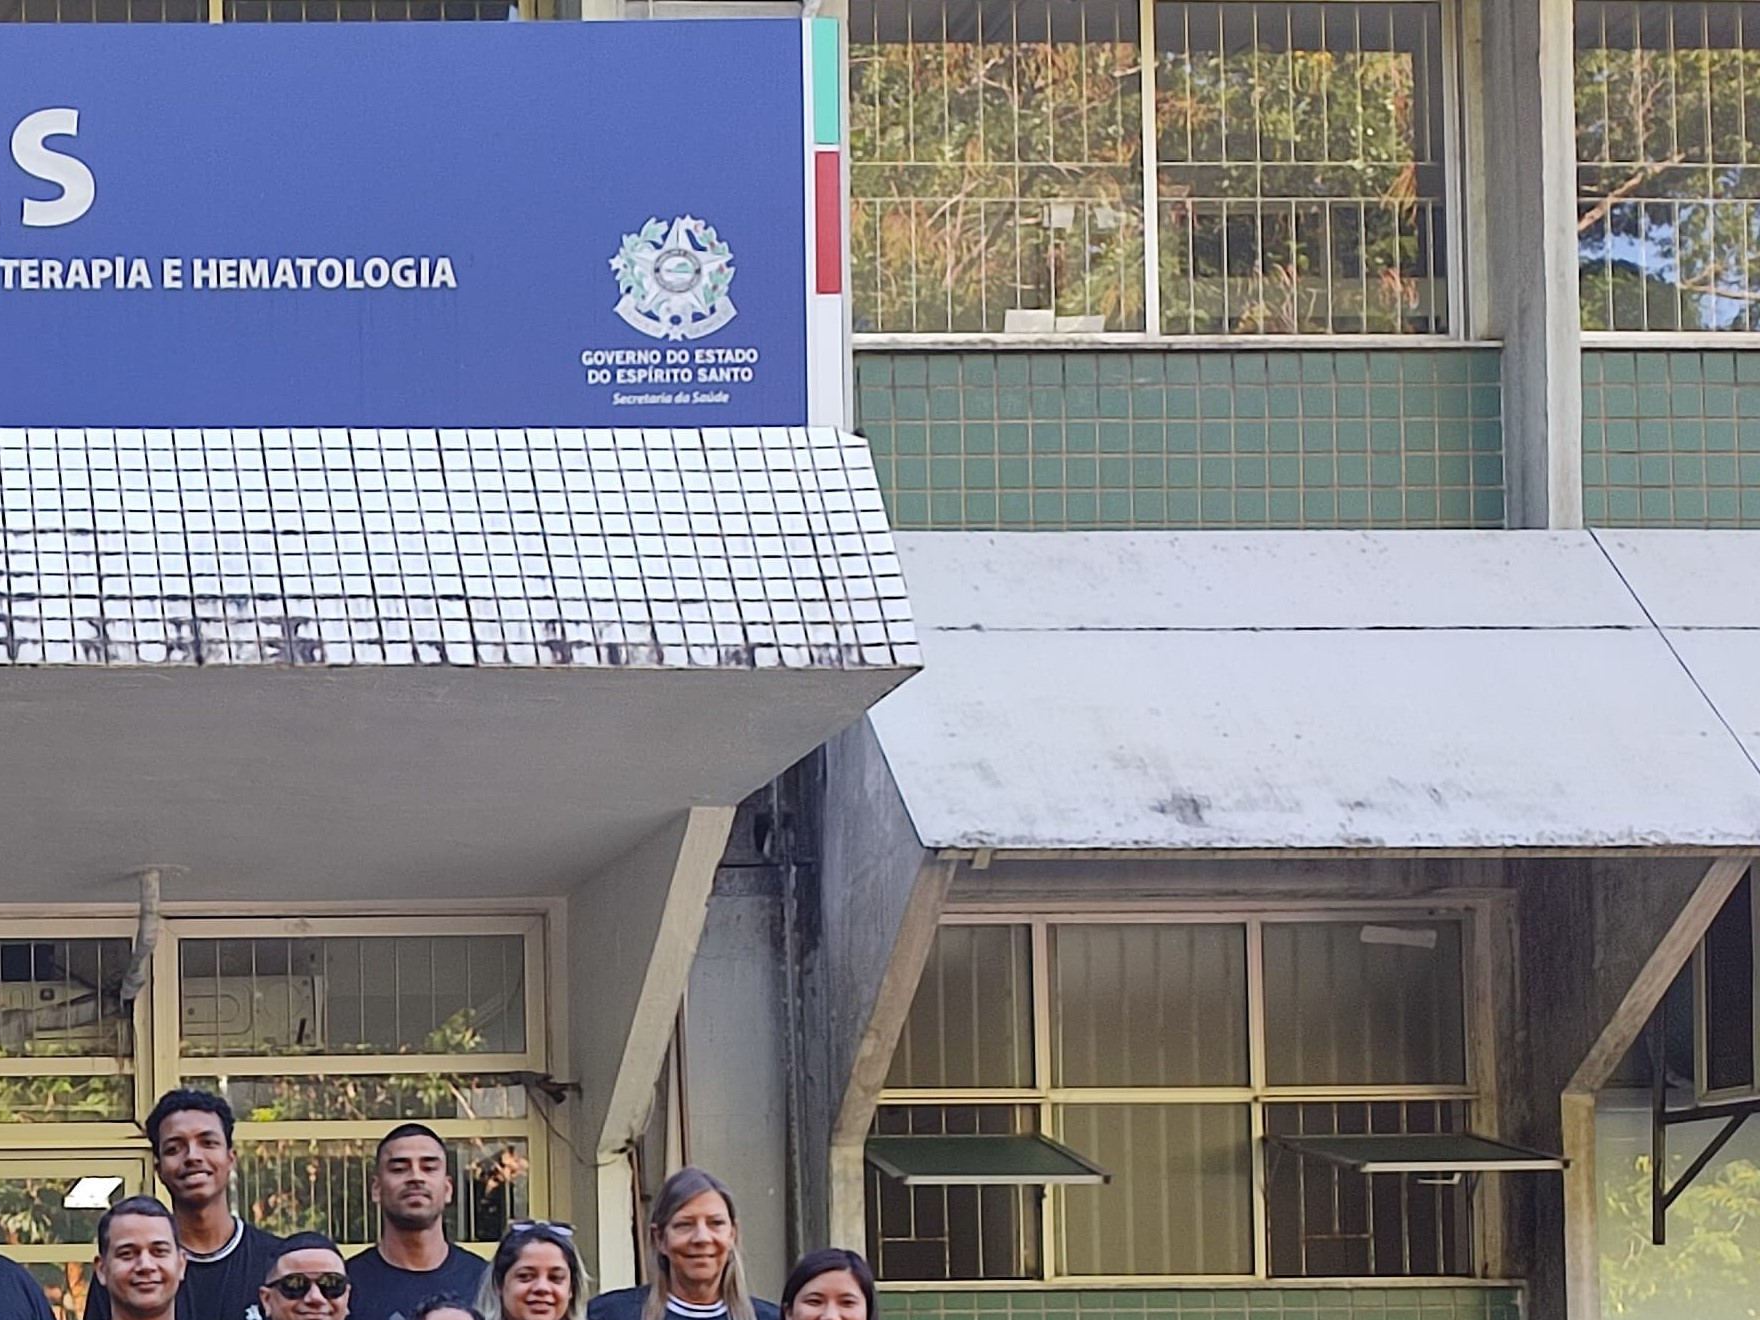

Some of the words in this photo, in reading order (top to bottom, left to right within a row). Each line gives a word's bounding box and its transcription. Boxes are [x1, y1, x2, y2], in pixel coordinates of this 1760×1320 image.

[163, 258, 183, 289] E
[192, 257, 457, 289] HEMATOLOGIA
[581, 349, 662, 366] GOVERNO
[666, 349, 690, 365] DO
[694, 348, 759, 364] ESTADO
[587, 368, 612, 385] DO
[616, 365, 693, 384] ESPÍRITO
[697, 366, 753, 383] SANTO
